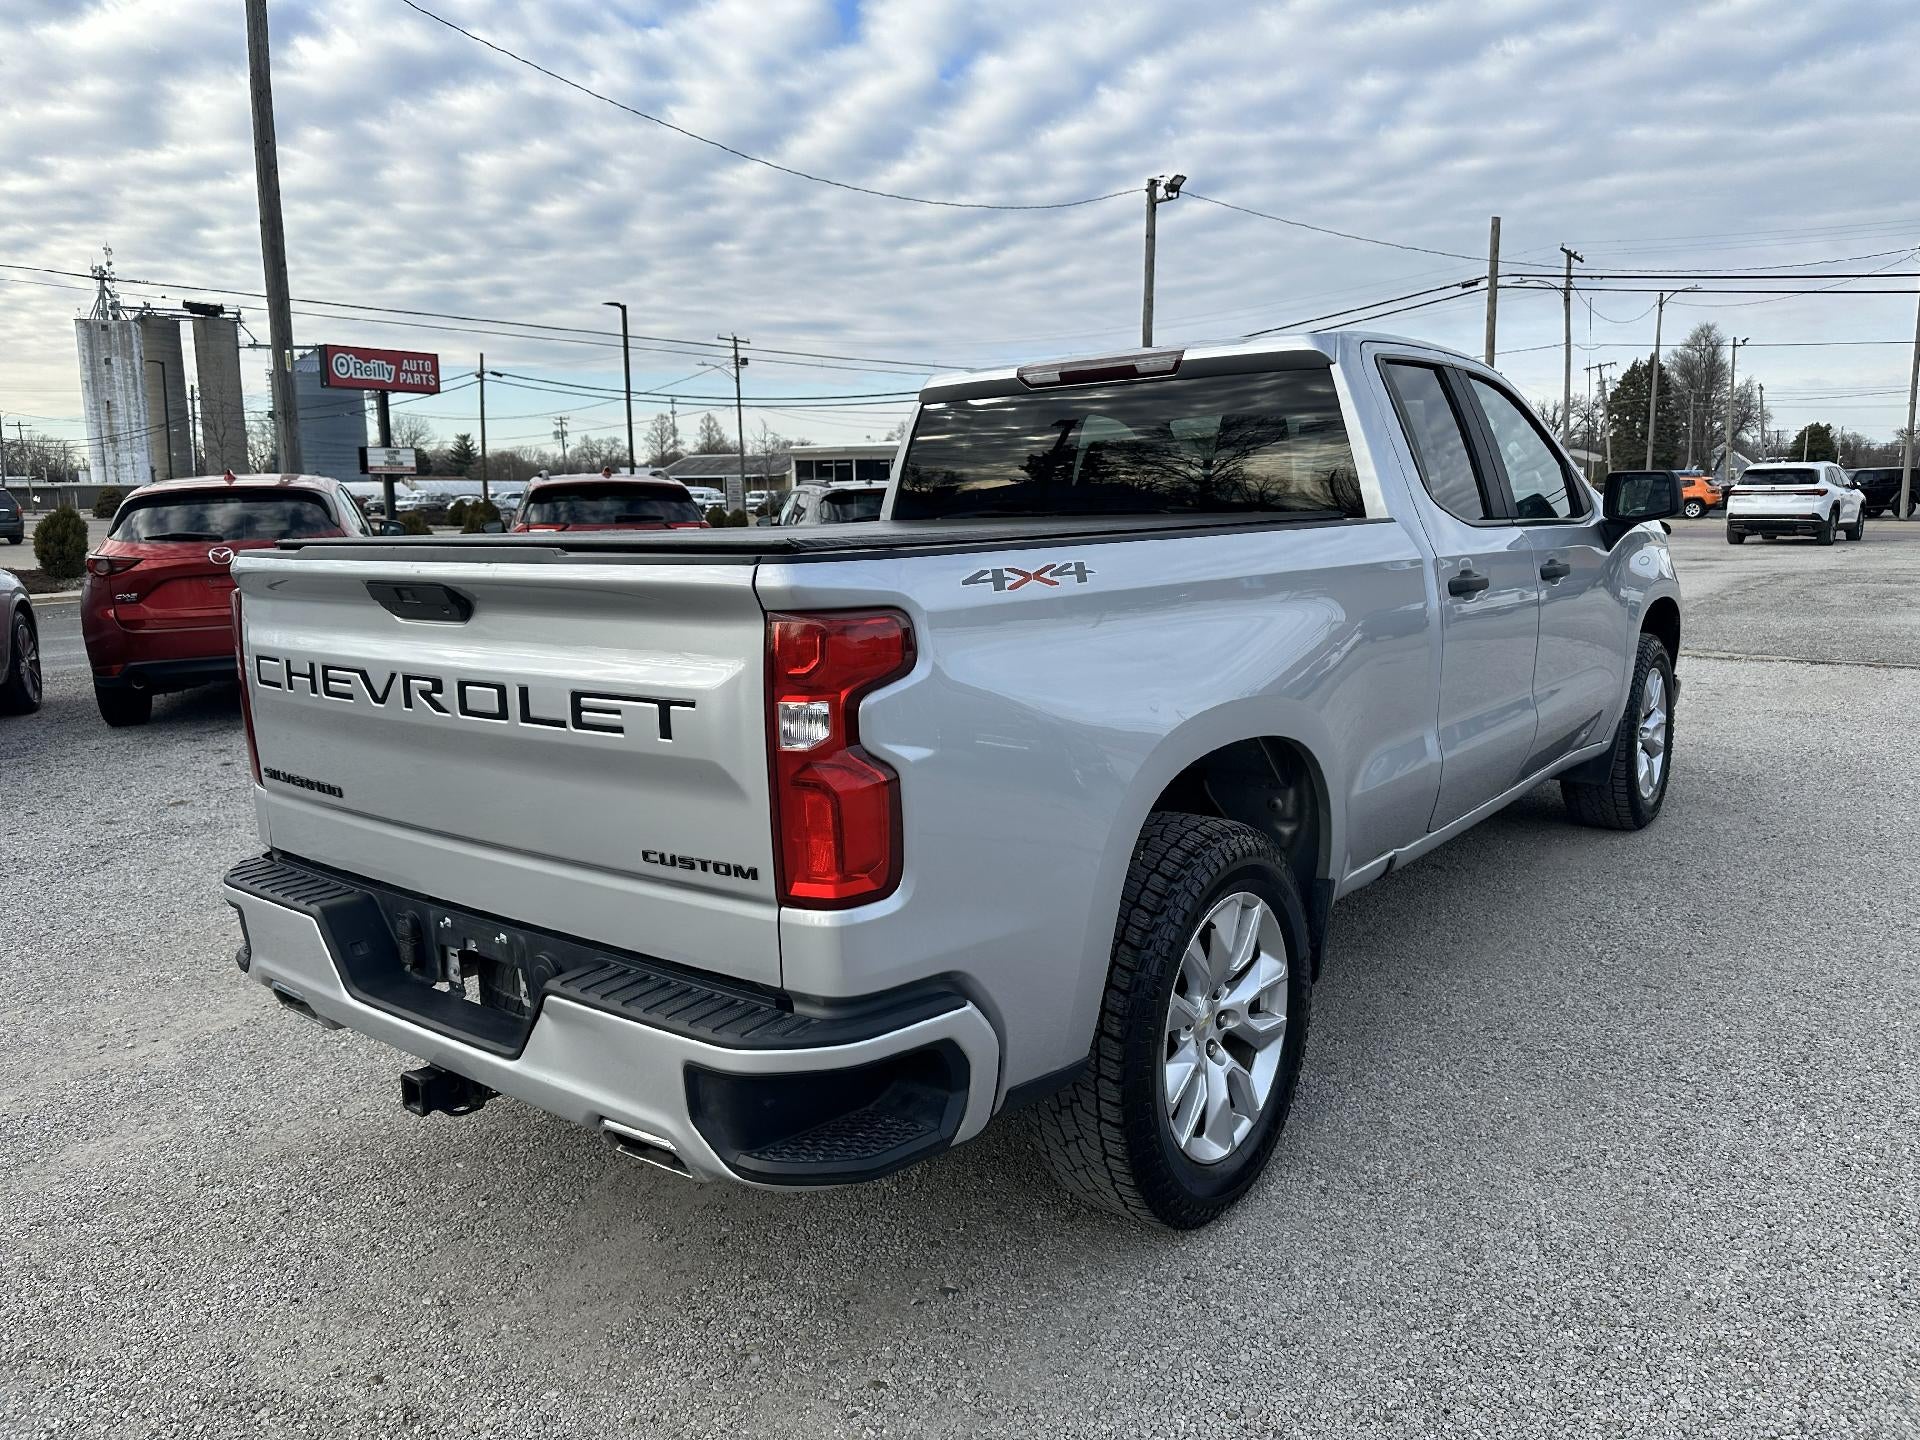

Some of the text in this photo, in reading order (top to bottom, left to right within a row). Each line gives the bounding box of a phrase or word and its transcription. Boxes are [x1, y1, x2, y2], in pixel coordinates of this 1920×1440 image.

[333, 354, 394, 382] O'Reilly
[399, 372, 436, 386] PARTS
[402, 359, 432, 372] AUTO
[255, 654, 697, 742] CHEVROLET
[263, 766, 344, 798] SILVERADO
[641, 849, 759, 881] CUSTOM
